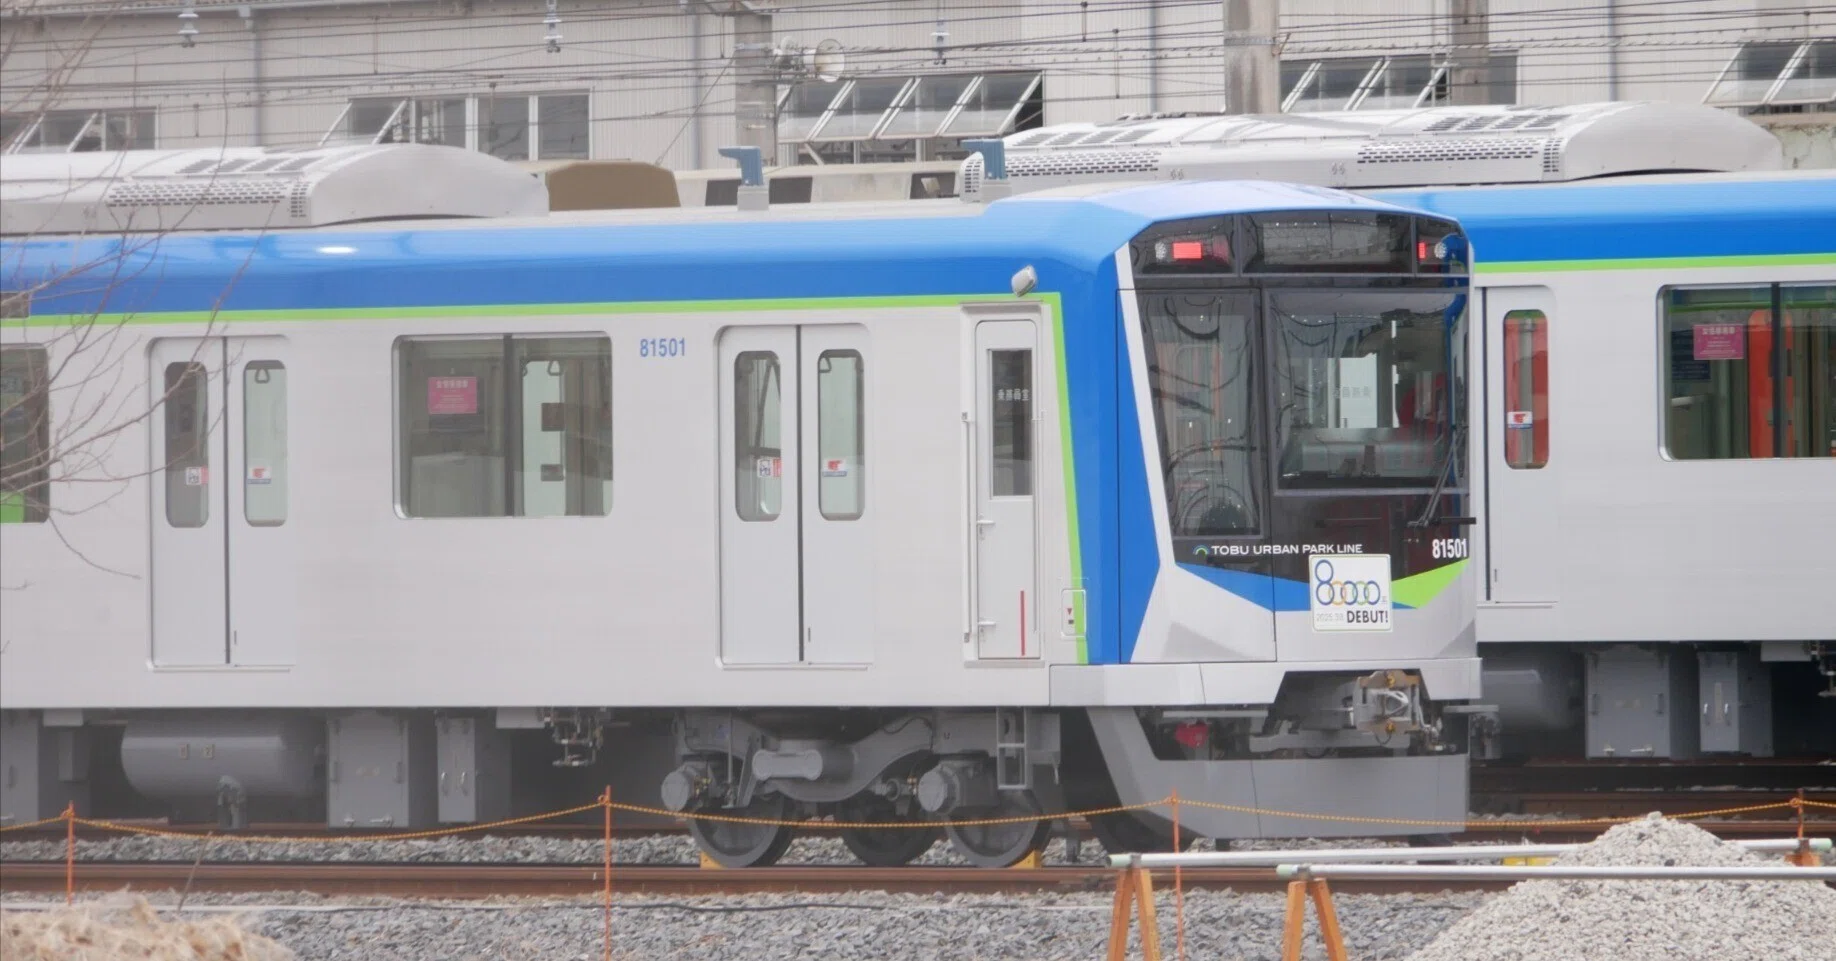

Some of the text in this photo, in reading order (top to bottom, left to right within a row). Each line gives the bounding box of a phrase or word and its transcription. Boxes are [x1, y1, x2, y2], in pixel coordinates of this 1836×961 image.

[640, 338, 685, 357] 81501
[1211, 543, 1363, 555] TOBU URBAN PARK LINE
[1432, 538, 1467, 559] 81501
[1346, 610, 1389, 623] DEBUT!
